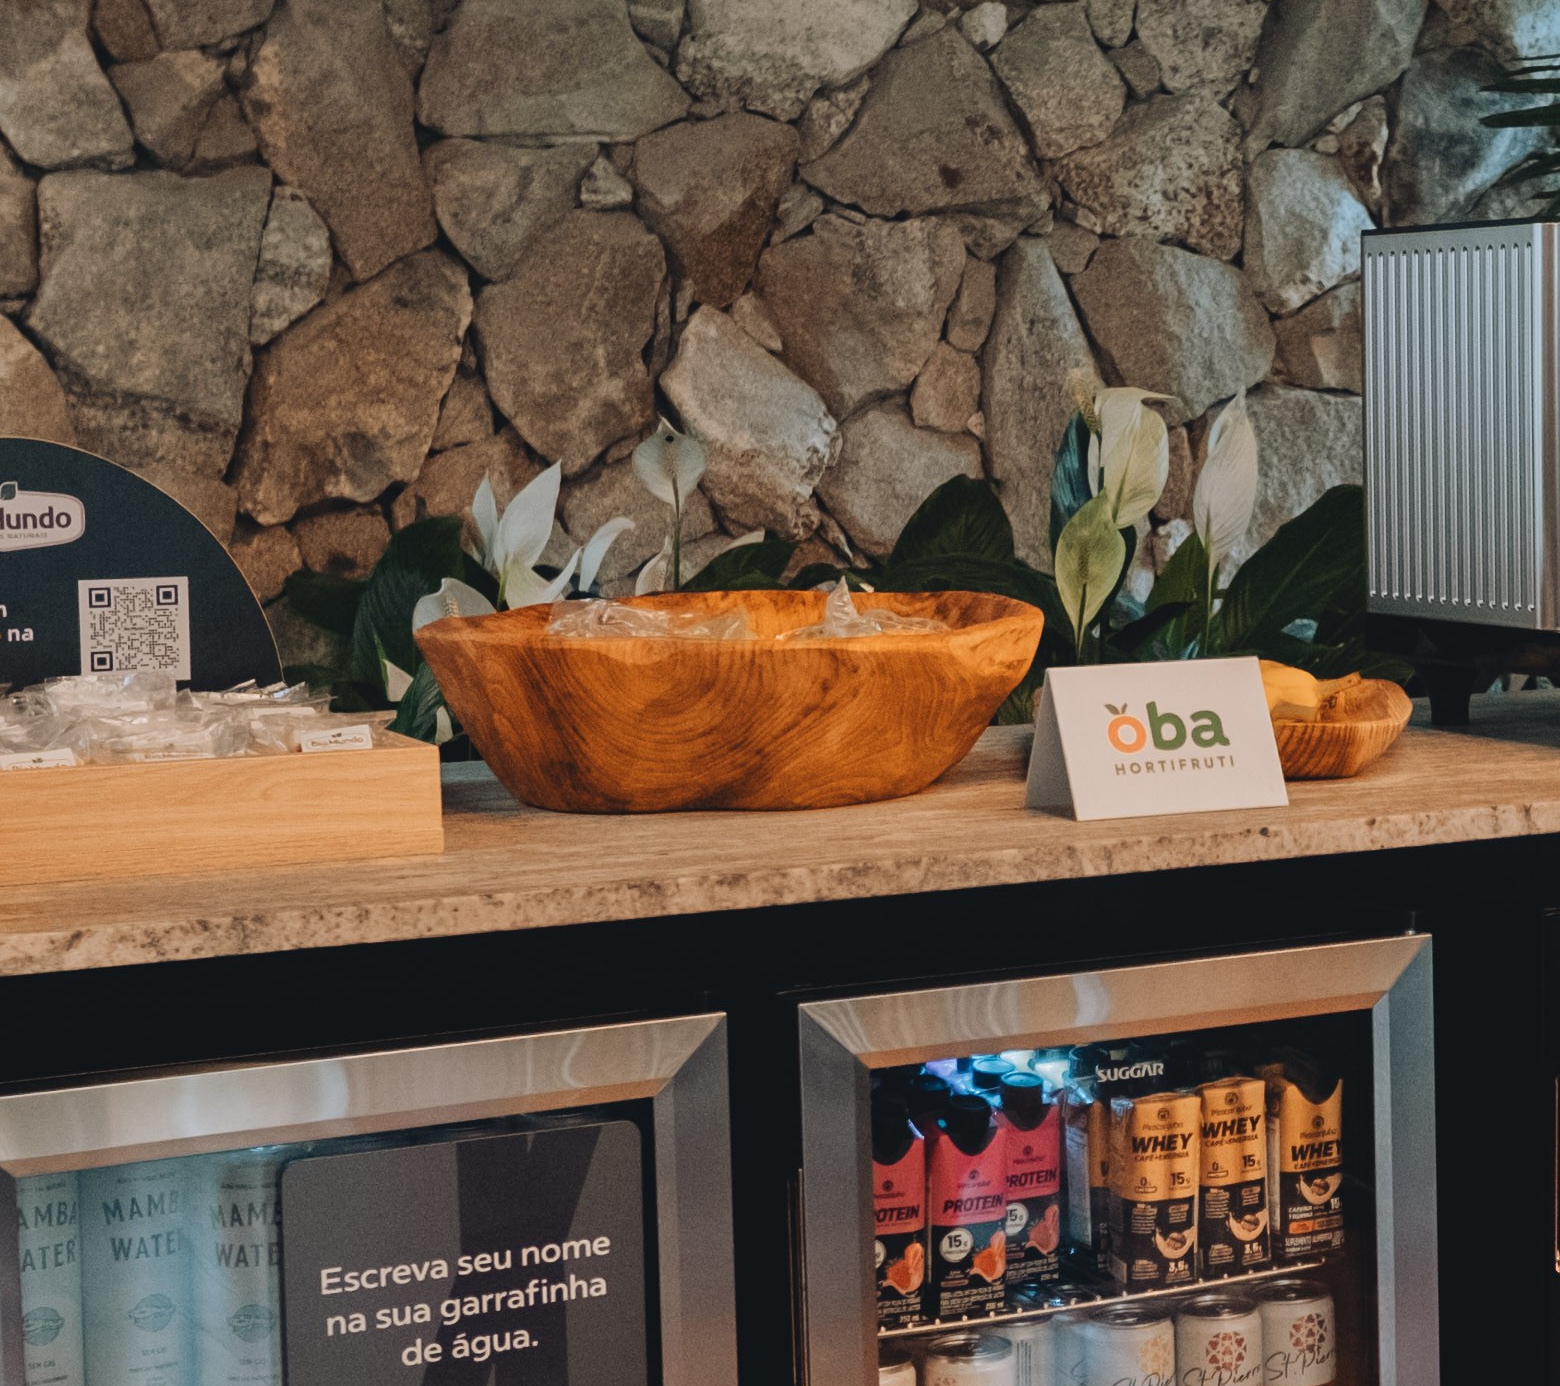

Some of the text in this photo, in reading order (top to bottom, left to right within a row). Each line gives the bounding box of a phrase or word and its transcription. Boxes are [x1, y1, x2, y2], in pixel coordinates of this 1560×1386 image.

[7, 627, 35, 642] na
[1114, 755, 1236, 777] HORTIFRUTI
[1096, 1063, 1165, 1083] SUGGAR
[1202, 1115, 1262, 1139] WHEY
[1131, 1132, 1194, 1154] WHEY
[102, 1189, 181, 1227] MAMB
[874, 1205, 920, 1222] OTEIN
[943, 1192, 1005, 1213] PROTEIN
[21, 1237, 78, 1274] ATER
[215, 1241, 281, 1268] WATE
[320, 1236, 611, 1296] Escreva seu nome
[326, 1274, 608, 1337] na sua garrafinha
[401, 1329, 540, 1367] de água.
